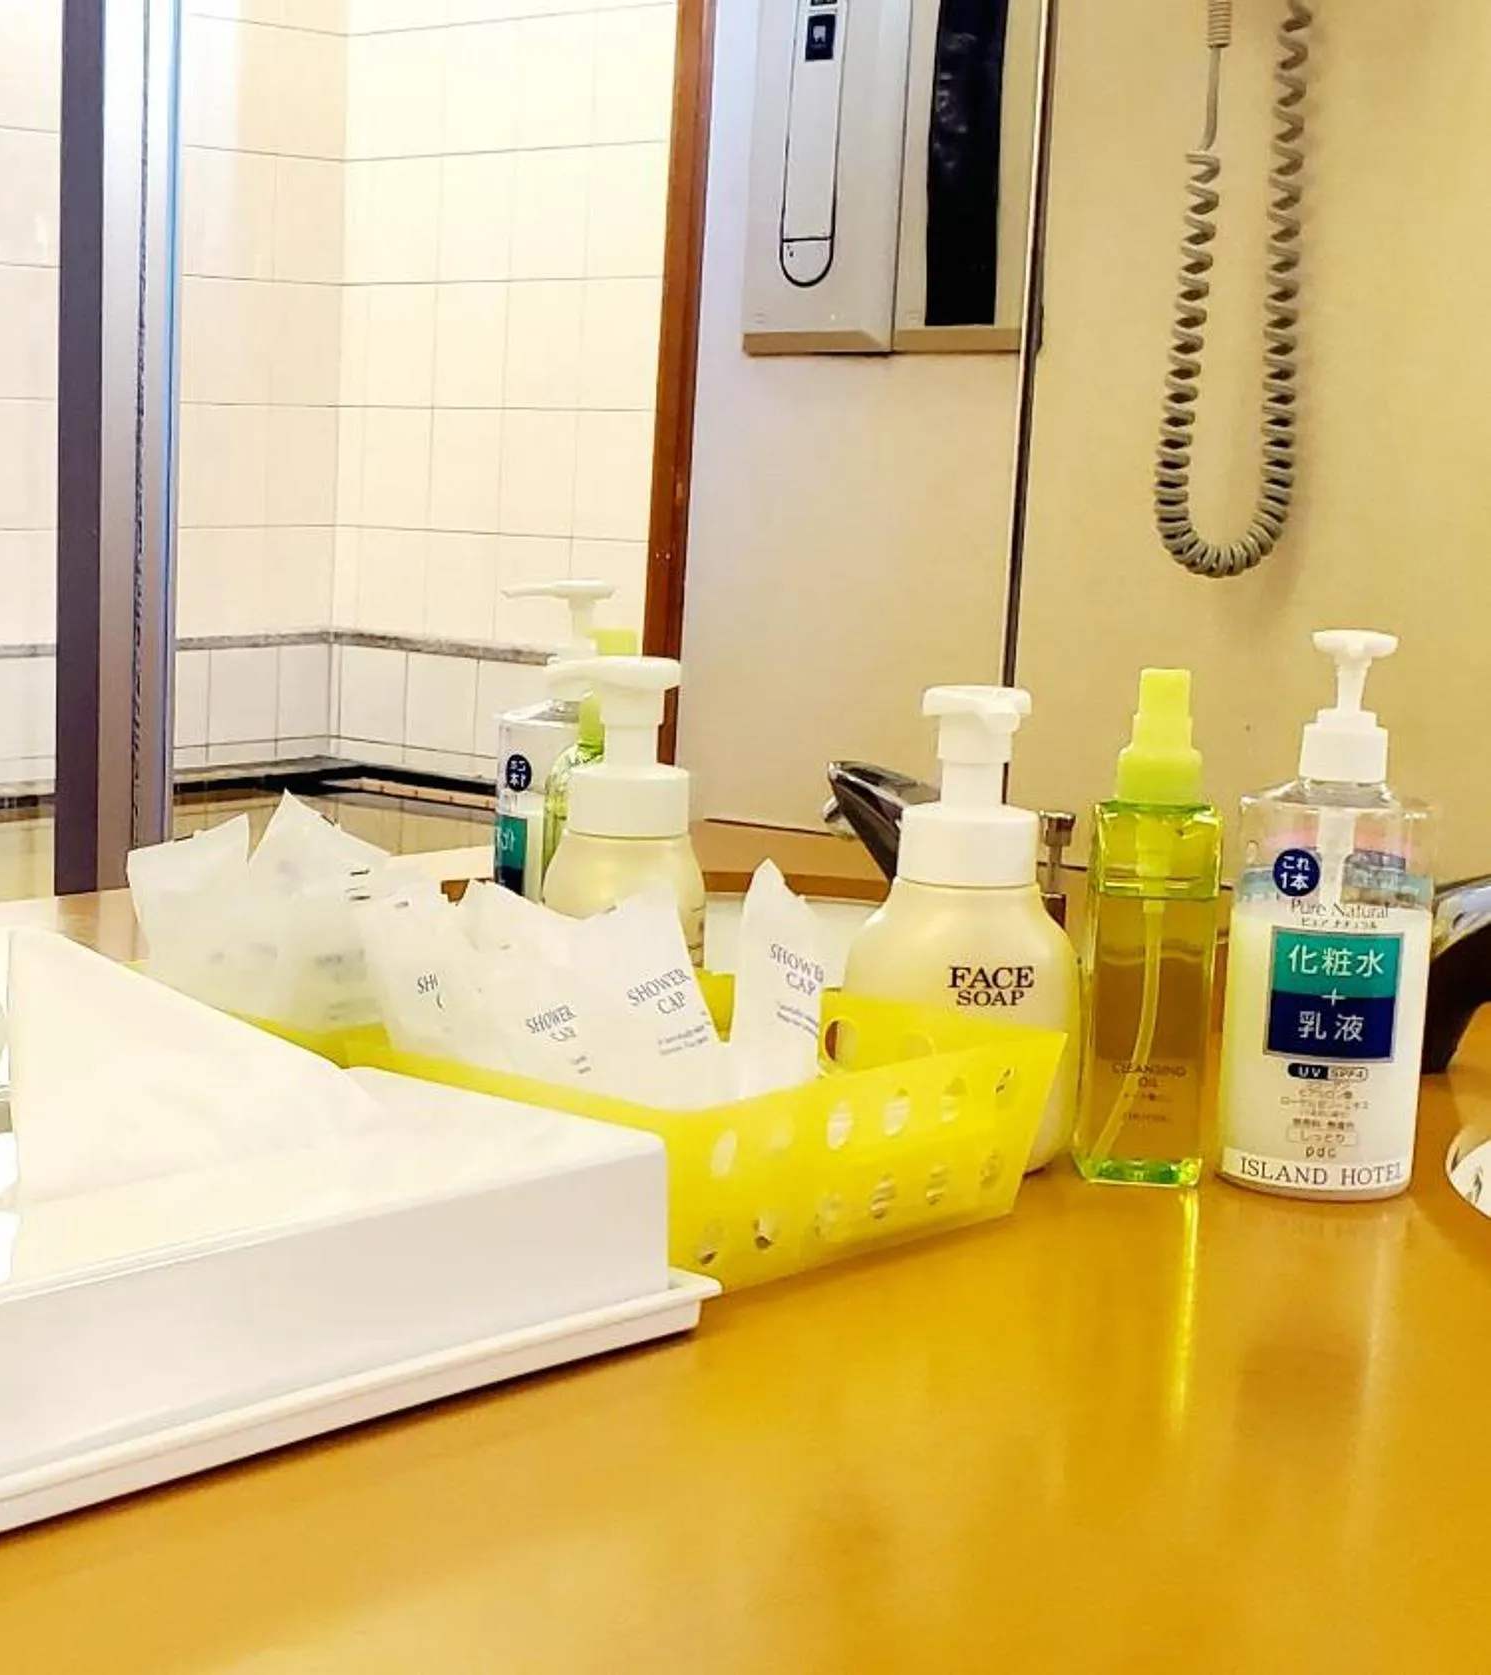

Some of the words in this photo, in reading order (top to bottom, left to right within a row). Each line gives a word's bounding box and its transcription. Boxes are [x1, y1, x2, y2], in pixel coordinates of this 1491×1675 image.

[1282, 855, 1311, 871] これ
[1280, 871, 1310, 891] 1本
[1290, 898, 1328, 917] Pure
[1331, 901, 1390, 919] Natural
[1288, 942, 1385, 978] 化粧水
[627, 968, 692, 1008] SHOWER
[785, 971, 816, 996] CAP
[948, 965, 1036, 990] FACE
[657, 991, 686, 1014] CAP
[956, 989, 1026, 1007] SOAP
[525, 1004, 577, 1035] SHOWER
[1297, 1010, 1365, 1043] 乳液
[1298, 1066, 1322, 1078] UV
[1300, 1129, 1346, 1144] しっとり
[1240, 1156, 1328, 1186] ISLAND
[1341, 1160, 1404, 1187] HOTEL
